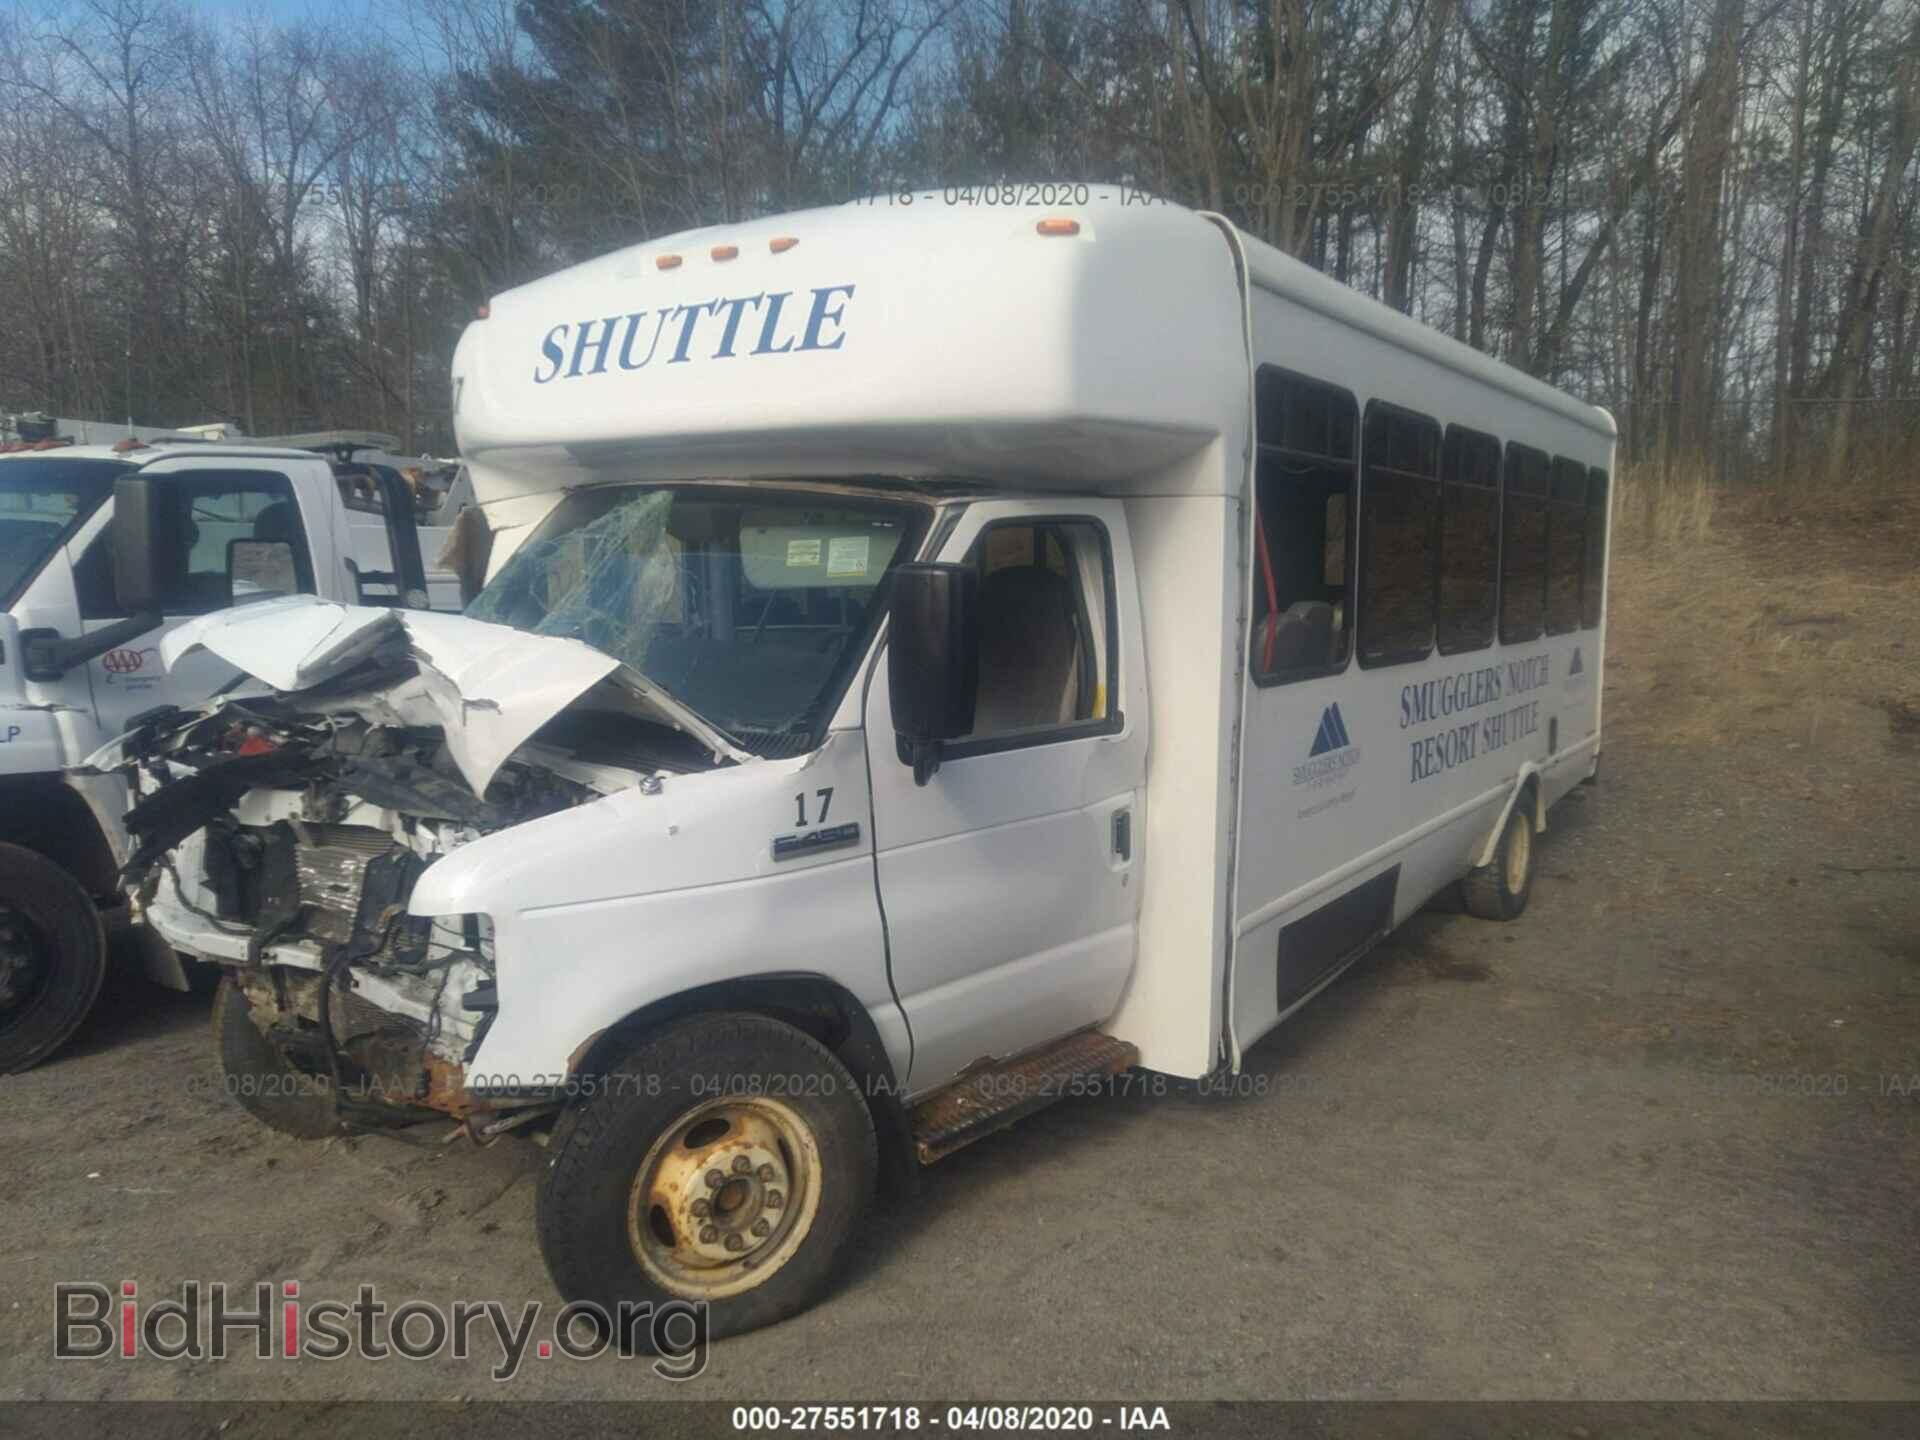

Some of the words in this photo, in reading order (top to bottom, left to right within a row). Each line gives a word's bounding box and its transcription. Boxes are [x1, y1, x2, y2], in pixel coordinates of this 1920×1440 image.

[533, 284, 856, 384] SHUTTLE
[104, 651, 142, 671] AAA
[1400, 666, 1503, 729] SMUGGLERS
[1506, 655, 1549, 696] NOTCH
[1411, 720, 1479, 783] RESORT
[1482, 700, 1538, 754] SHUTTLE
[795, 787, 834, 827] 17
